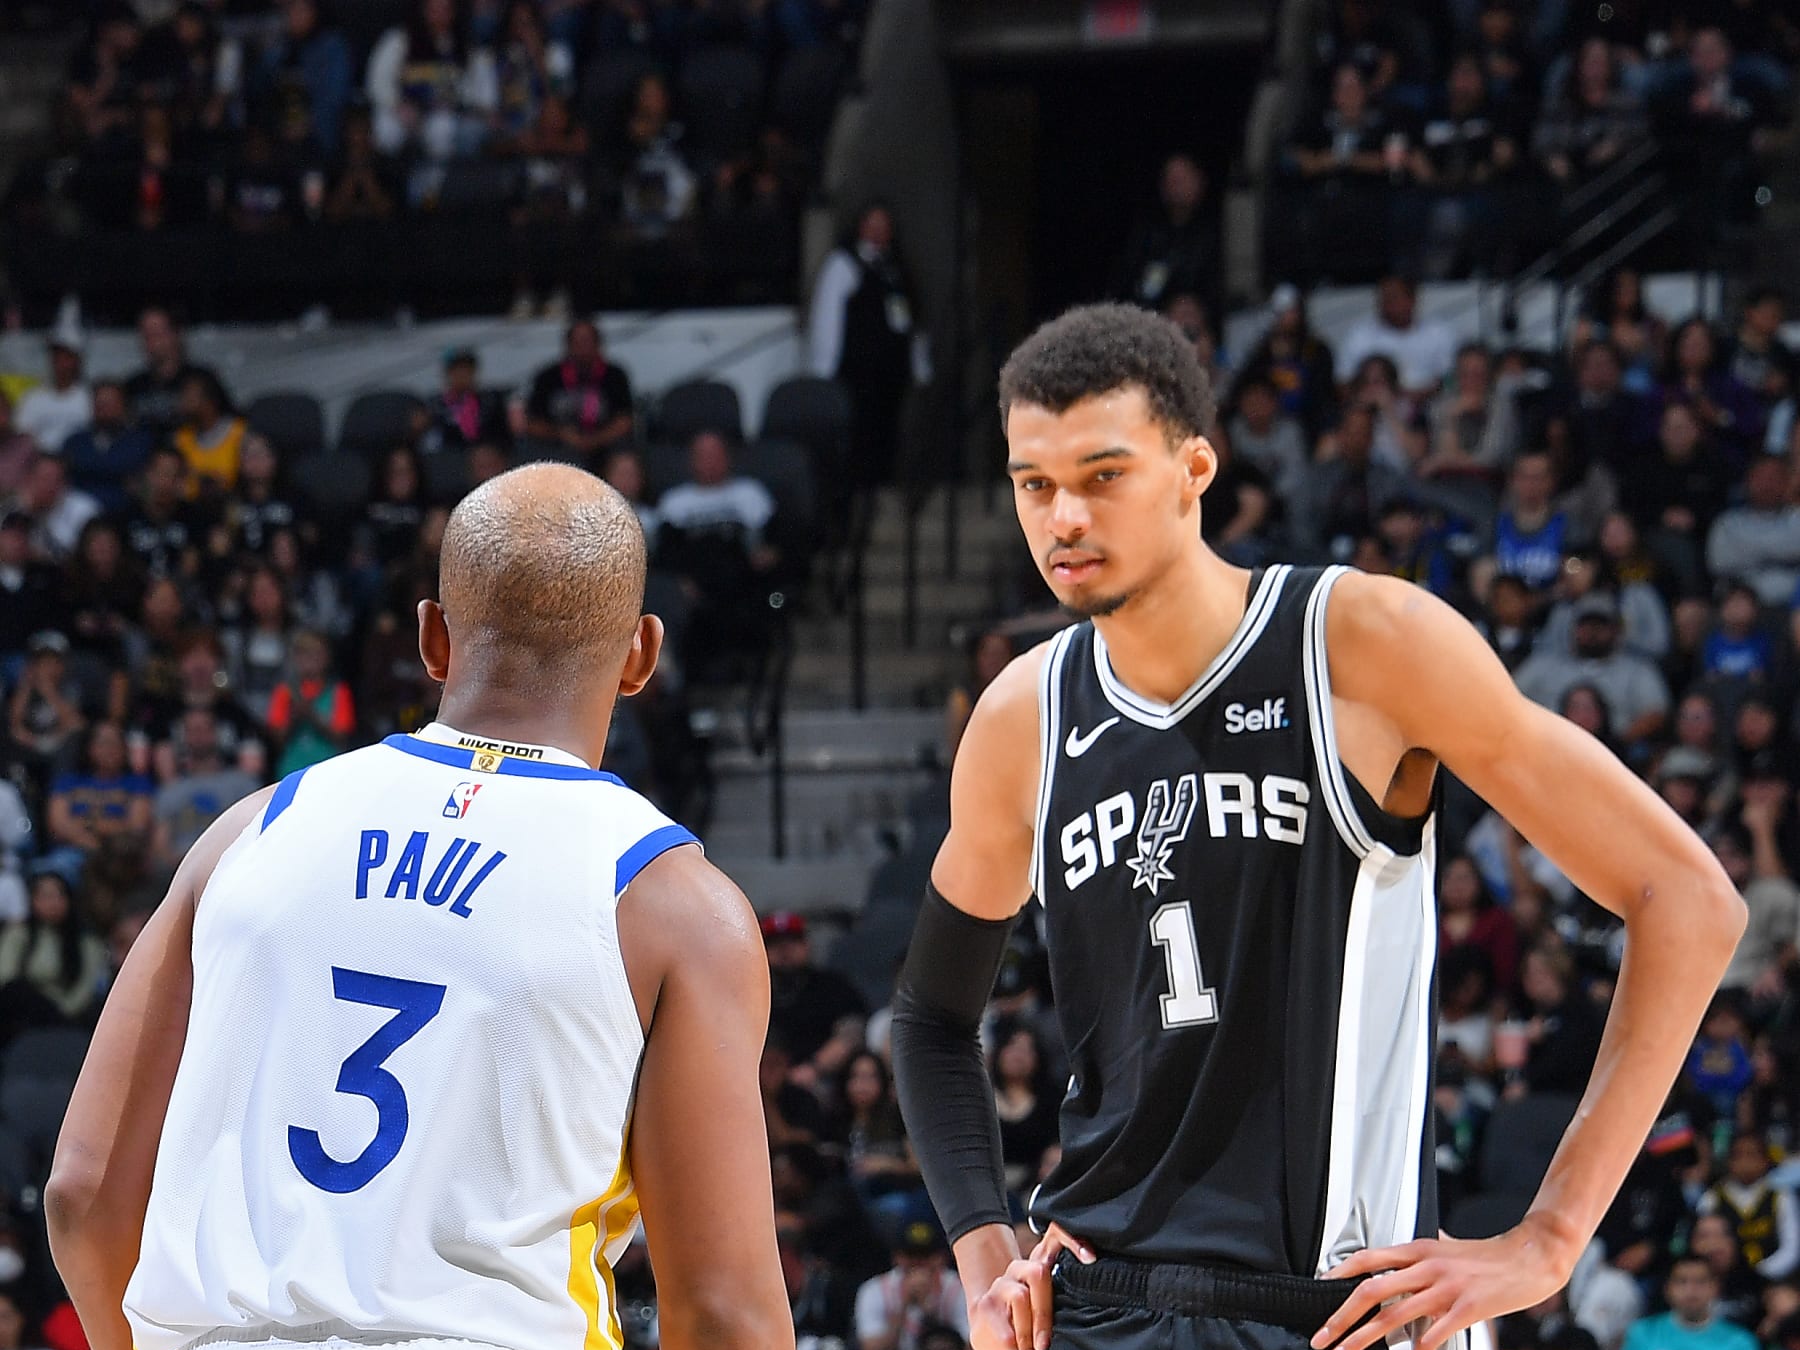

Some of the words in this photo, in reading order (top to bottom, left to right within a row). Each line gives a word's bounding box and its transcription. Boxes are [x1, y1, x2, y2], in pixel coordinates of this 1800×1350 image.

[1225, 697, 1289, 734] Self.
[355, 829, 508, 919] PAUL
[1060, 773, 1311, 896] SPURS
[1149, 900, 1219, 1030] 1
[287, 965, 447, 1194] 3
